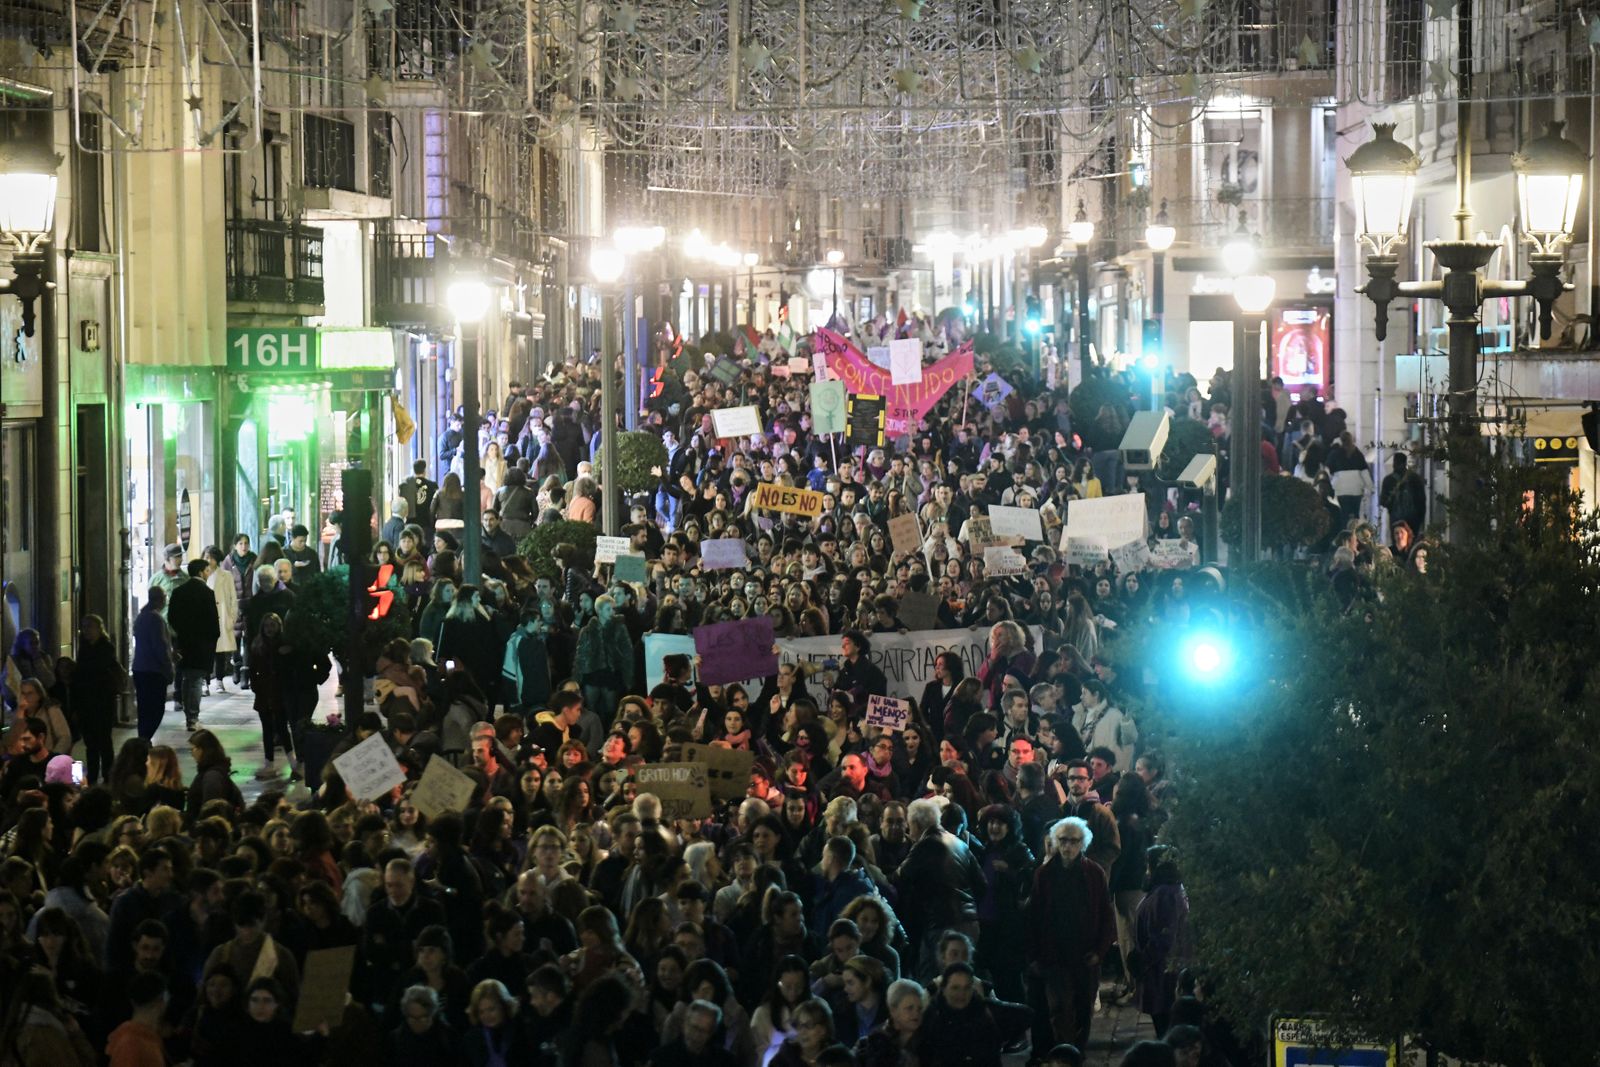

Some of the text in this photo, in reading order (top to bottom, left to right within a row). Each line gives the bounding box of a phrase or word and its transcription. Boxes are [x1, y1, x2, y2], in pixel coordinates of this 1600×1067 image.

[233, 333, 307, 366] 16H
[759, 487, 817, 511] NO ES NO
[870, 696, 881, 705] NI
[873, 705, 907, 720] MENOS
[638, 768, 671, 783] GRITO
